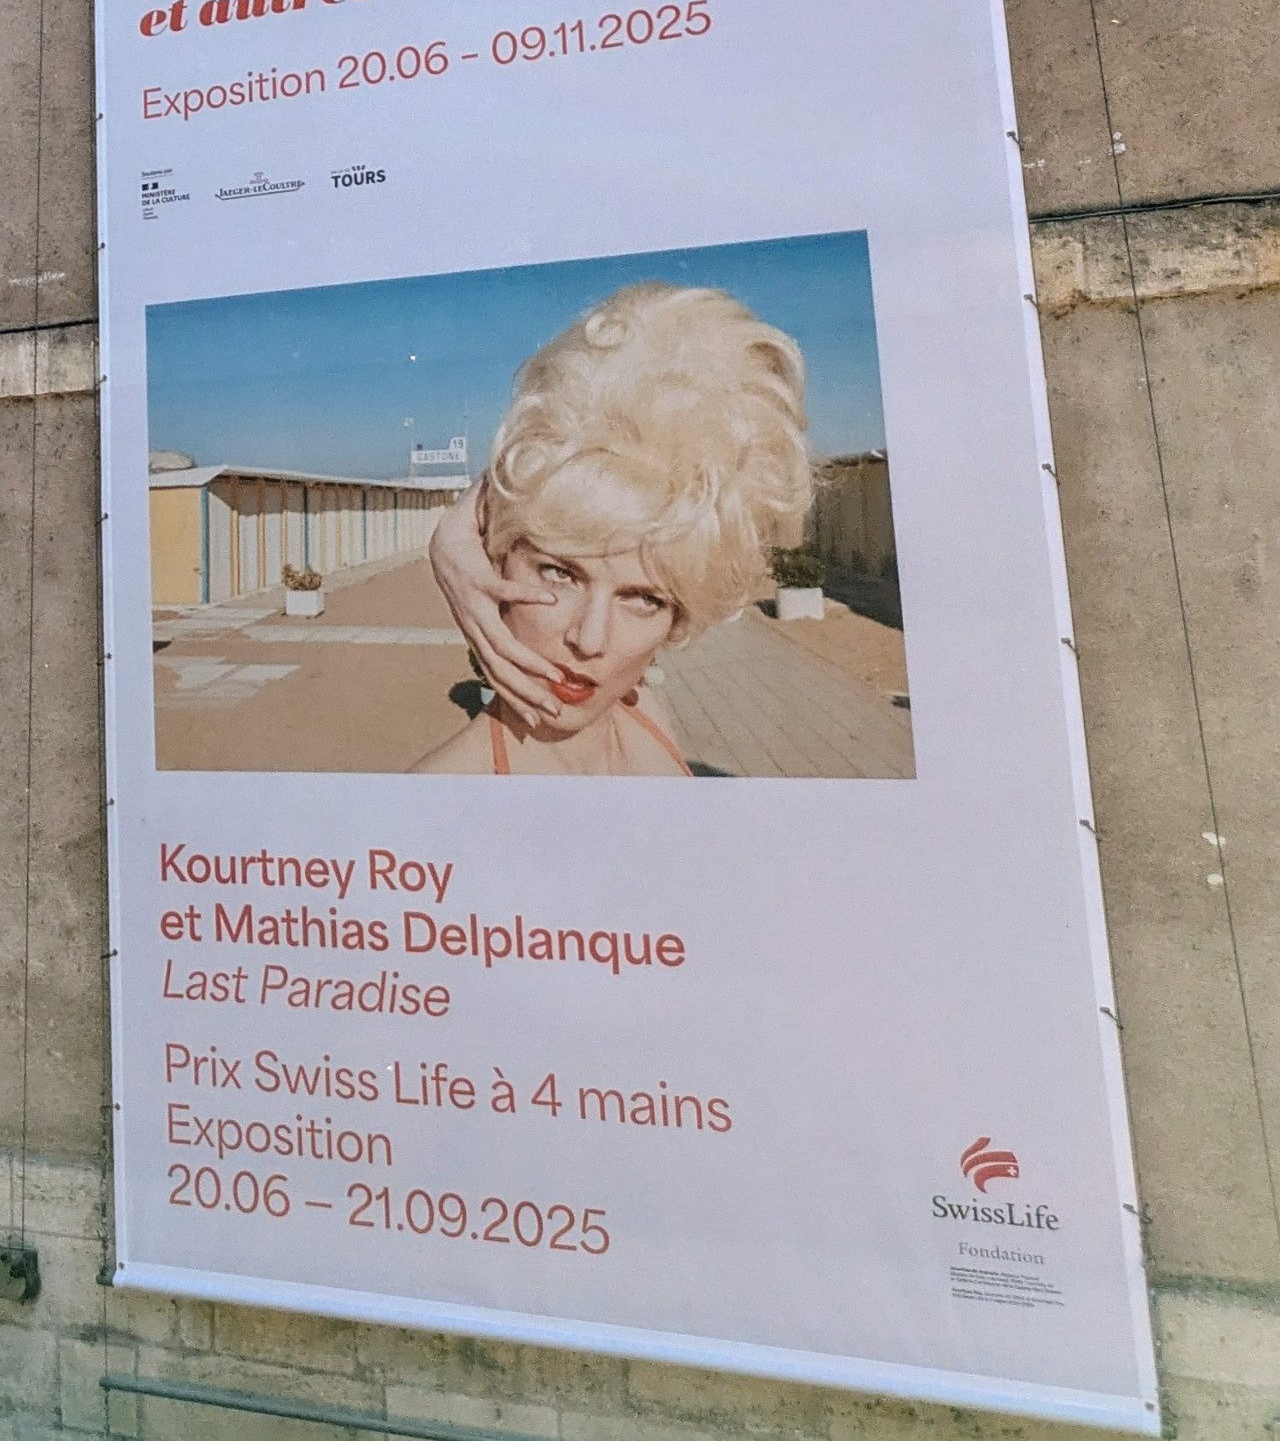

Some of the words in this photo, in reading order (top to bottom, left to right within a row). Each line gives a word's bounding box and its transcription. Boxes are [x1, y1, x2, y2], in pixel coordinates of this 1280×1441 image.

[142, 63, 326, 120] Exposition
[337, 40, 449, 90] 20.06
[491, 0, 712, 66] 09.11.2025
[161, 194, 190, 204] CULTURE
[331, 169, 386, 188] TOURS
[160, 843, 355, 899] Kourtney
[370, 848, 453, 903] Roy
[160, 904, 202, 942] et
[216, 904, 389, 953] Mathias
[403, 911, 686, 975] Delplanque
[162, 959, 247, 1004] Last
[261, 964, 451, 1017] Paradise
[165, 1043, 241, 1090] Prix
[255, 1049, 379, 1101] Swiss
[393, 1061, 476, 1110] Life
[491, 1067, 516, 1114] à
[531, 1073, 562, 1117] 4
[579, 1080, 734, 1134] mains
[166, 1103, 393, 1167] Exposition
[168, 1163, 291, 1217] 20.06
[347, 1182, 611, 1255] 21.09.2025
[932, 1195, 1060, 1231] SwissLife
[958, 1241, 1044, 1265] Fondation
